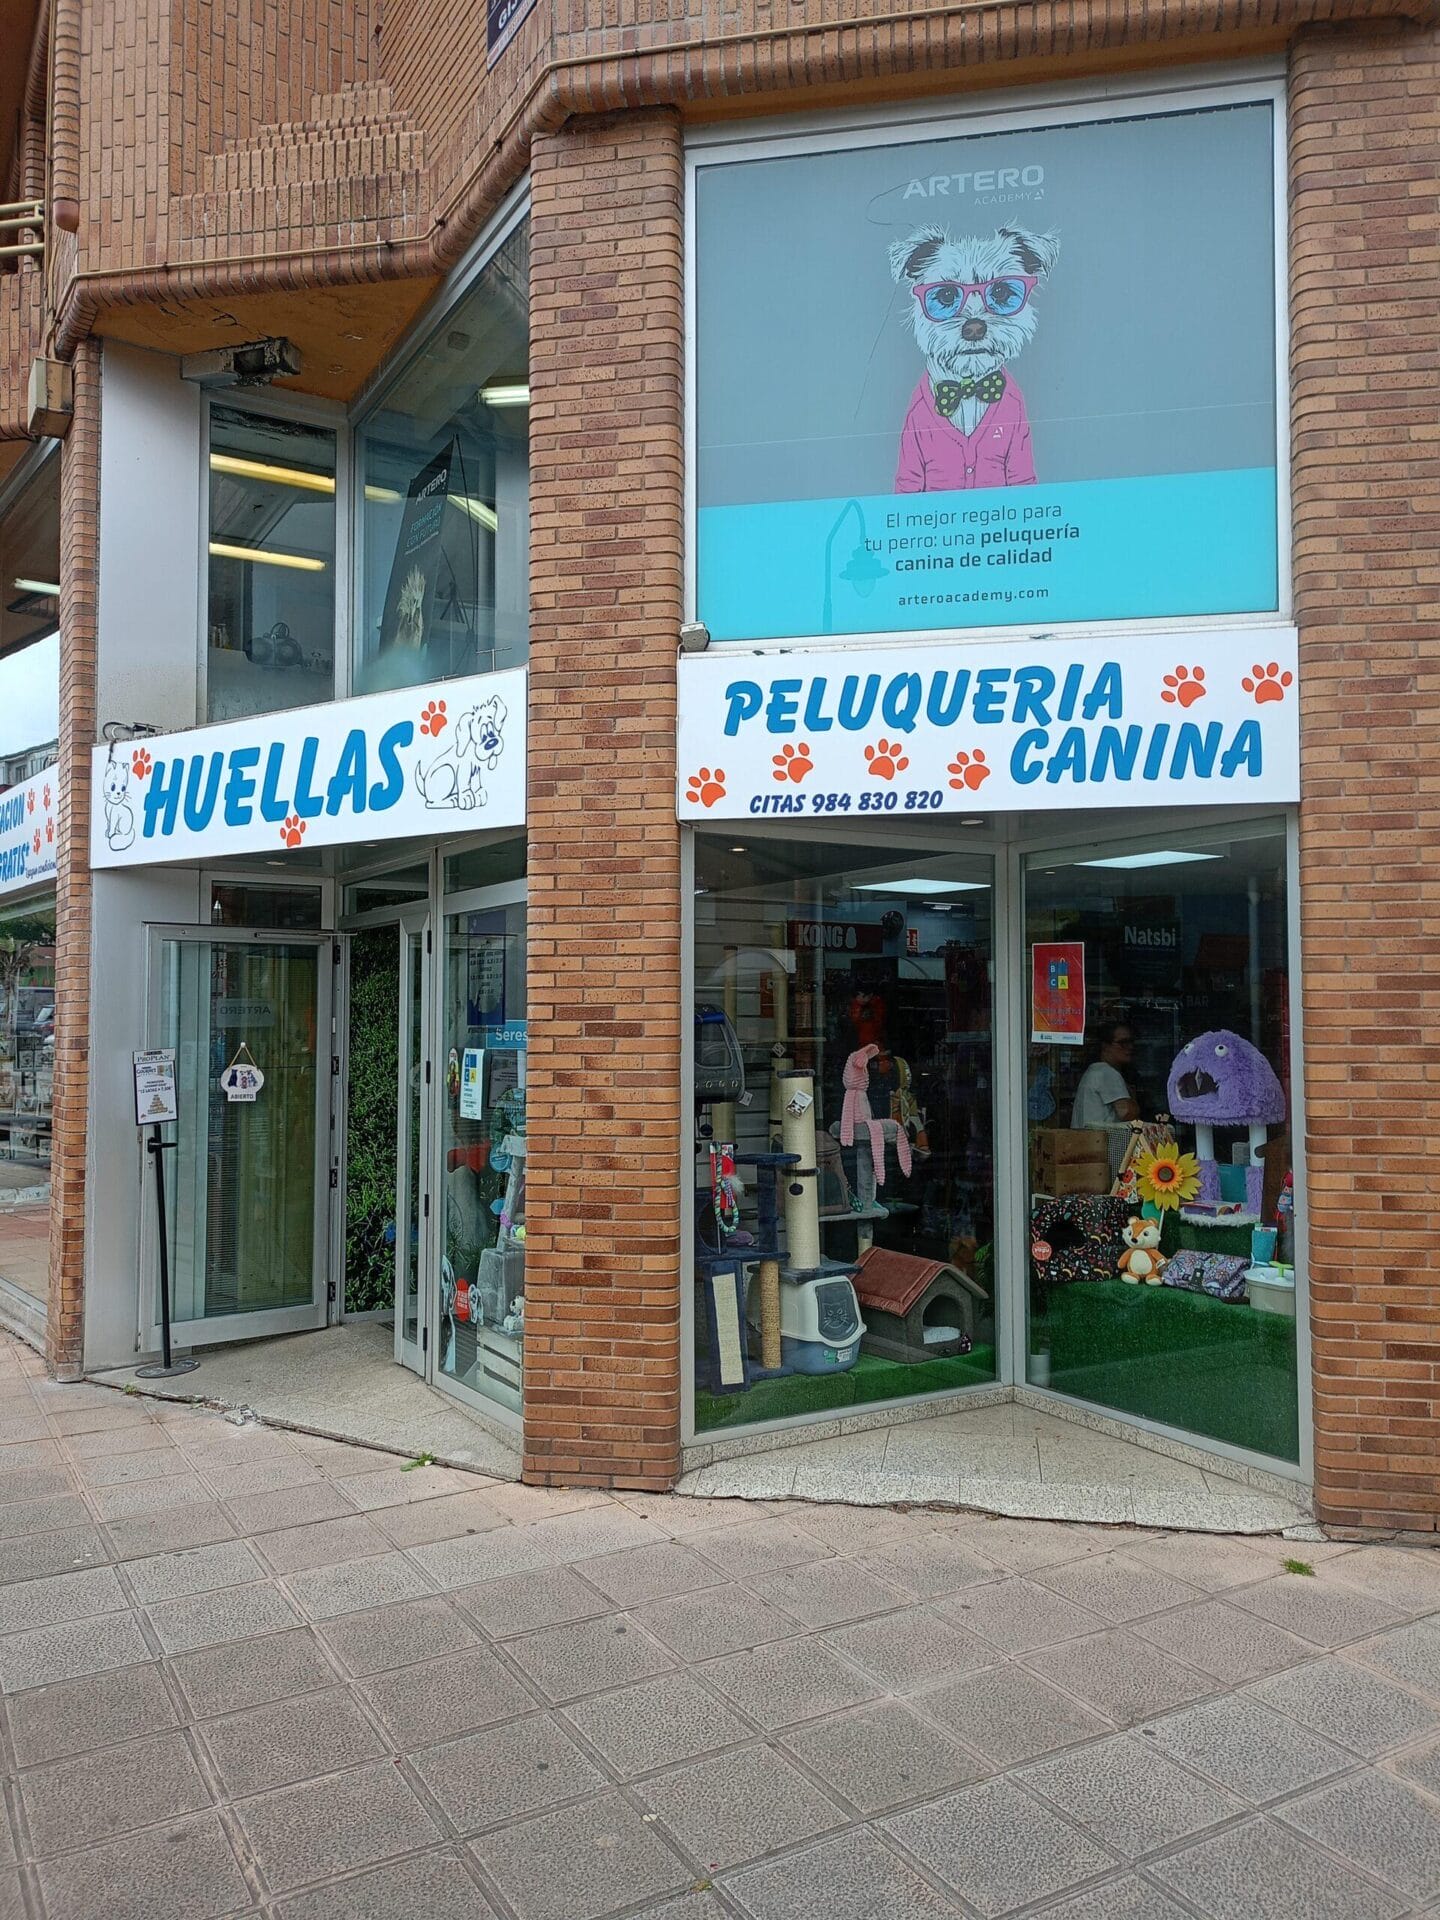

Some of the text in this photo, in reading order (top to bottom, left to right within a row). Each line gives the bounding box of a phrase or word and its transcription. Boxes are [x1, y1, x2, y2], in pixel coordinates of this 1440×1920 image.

[902, 165, 1045, 200] ARTERO
[974, 191, 1033, 206] ACADEMY
[415, 468, 448, 506] ARTERO
[886, 505, 1063, 529] El mejor regalo para
[864, 523, 1080, 554] tu perro: una peluquería
[895, 547, 1052, 572] canina de calidad
[898, 587, 1050, 606] arteroacademy.com
[723, 660, 1124, 737] PELUQUERIA
[1009, 719, 1264, 786] CANINA
[142, 719, 415, 839] HUELLAS
[0, 792, 26, 836] ACION
[749, 789, 944, 815] CITAS 984 830 820
[798, 924, 843, 948] KONG
[1124, 926, 1176, 947] Natsbi
